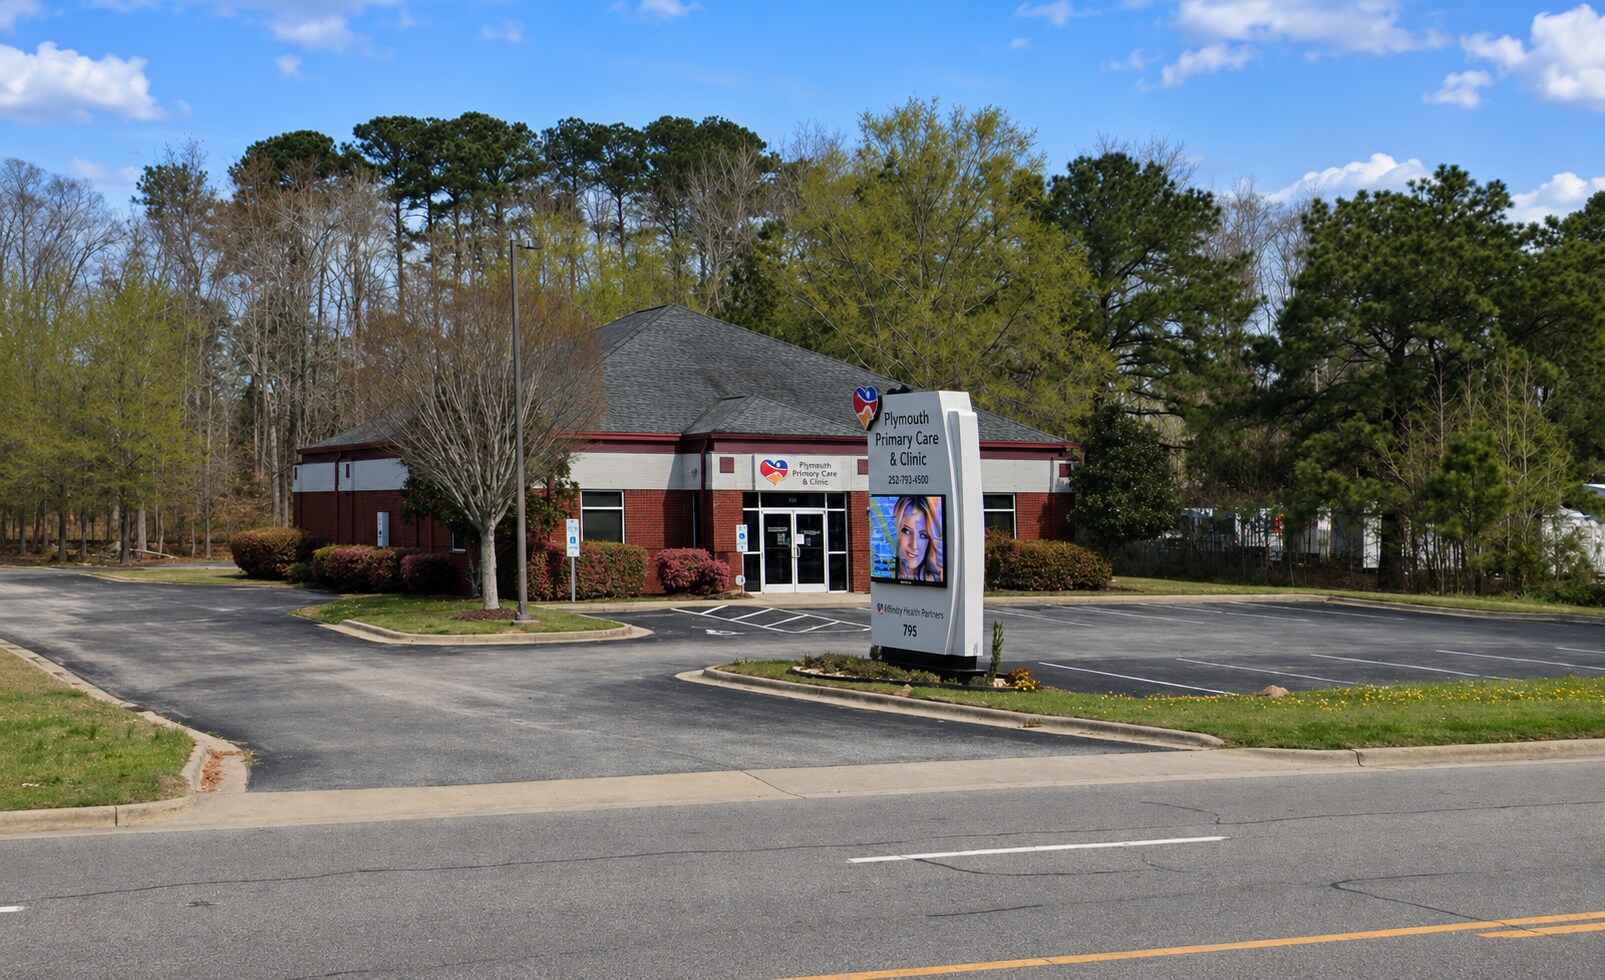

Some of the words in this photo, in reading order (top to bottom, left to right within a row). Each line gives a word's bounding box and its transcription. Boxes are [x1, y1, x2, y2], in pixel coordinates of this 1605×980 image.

[884, 410, 929, 429] Plymouth
[875, 432, 913, 449] Primary
[916, 431, 939, 445] Care
[799, 461, 832, 470] Plymouth
[890, 452, 897, 466] &
[900, 452, 927, 466] Clinic
[792, 470, 819, 478] Primary
[822, 470, 838, 478] Care
[888, 475, 929, 485] 252-793-4500
[809, 478, 829, 486] Clinic
[903, 606, 920, 618] Health
[921, 608, 945, 620] Partners
[903, 624, 918, 638] 795
